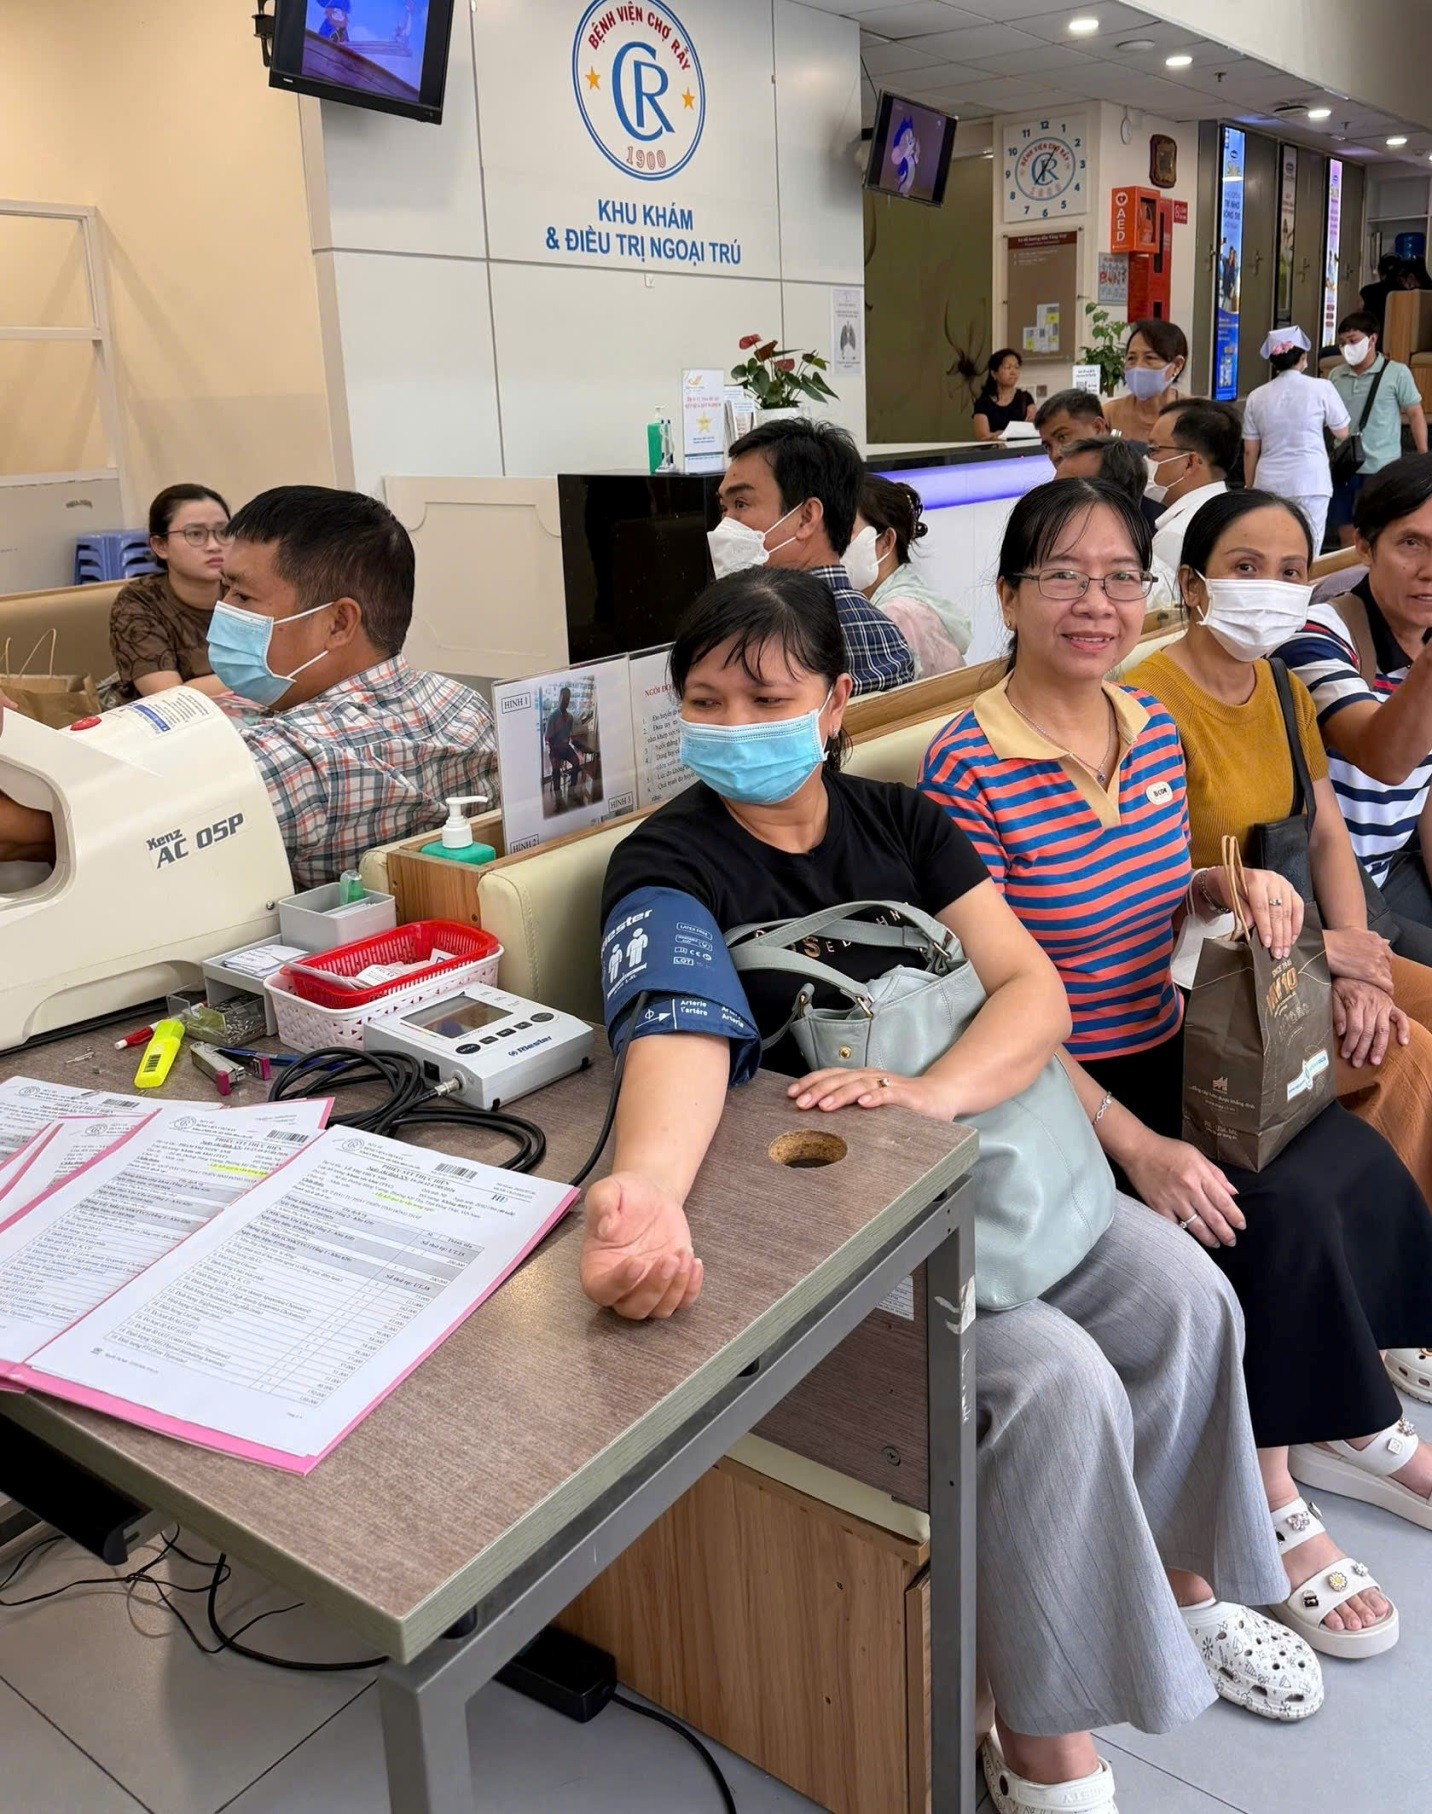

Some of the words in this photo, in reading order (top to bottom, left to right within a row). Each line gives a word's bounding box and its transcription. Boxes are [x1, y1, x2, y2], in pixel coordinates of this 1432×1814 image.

[588, 11, 617, 50] BỆNH
[616, 1, 643, 25] VIỆN
[647, 12, 672, 42] CHỢ
[1041, 120, 1049, 130] 12
[1061, 123, 1066, 133] 1
[1022, 129, 1031, 138] 11
[1074, 138, 1081, 147] 2
[1008, 147, 1018, 156] 10
[626, 146, 667, 170] 1900
[1080, 160, 1086, 169] 3
[1005, 170, 1011, 179] 9
[1074, 183, 1080, 192] 4
[1010, 191, 1016, 200] 8
[1060, 200, 1067, 209] 5
[598, 199, 637, 225] KHU
[643, 202, 694, 230] KHÁM
[1024, 206, 1030, 215] 7
[1042, 208, 1048, 217] 6
[1116, 208, 1126, 242] AED
[546, 226, 560, 250] &
[565, 225, 611, 254] ĐIỀU
[616, 234, 646, 262] TRỊ
[650, 236, 705, 266] NGOẠI
[709, 239, 742, 264] TRÚ
[504, 696, 523, 710] HÌNH
[524, 696, 529, 706] 1
[146, 829, 183, 851] Kenz
[157, 838, 189, 870] AC
